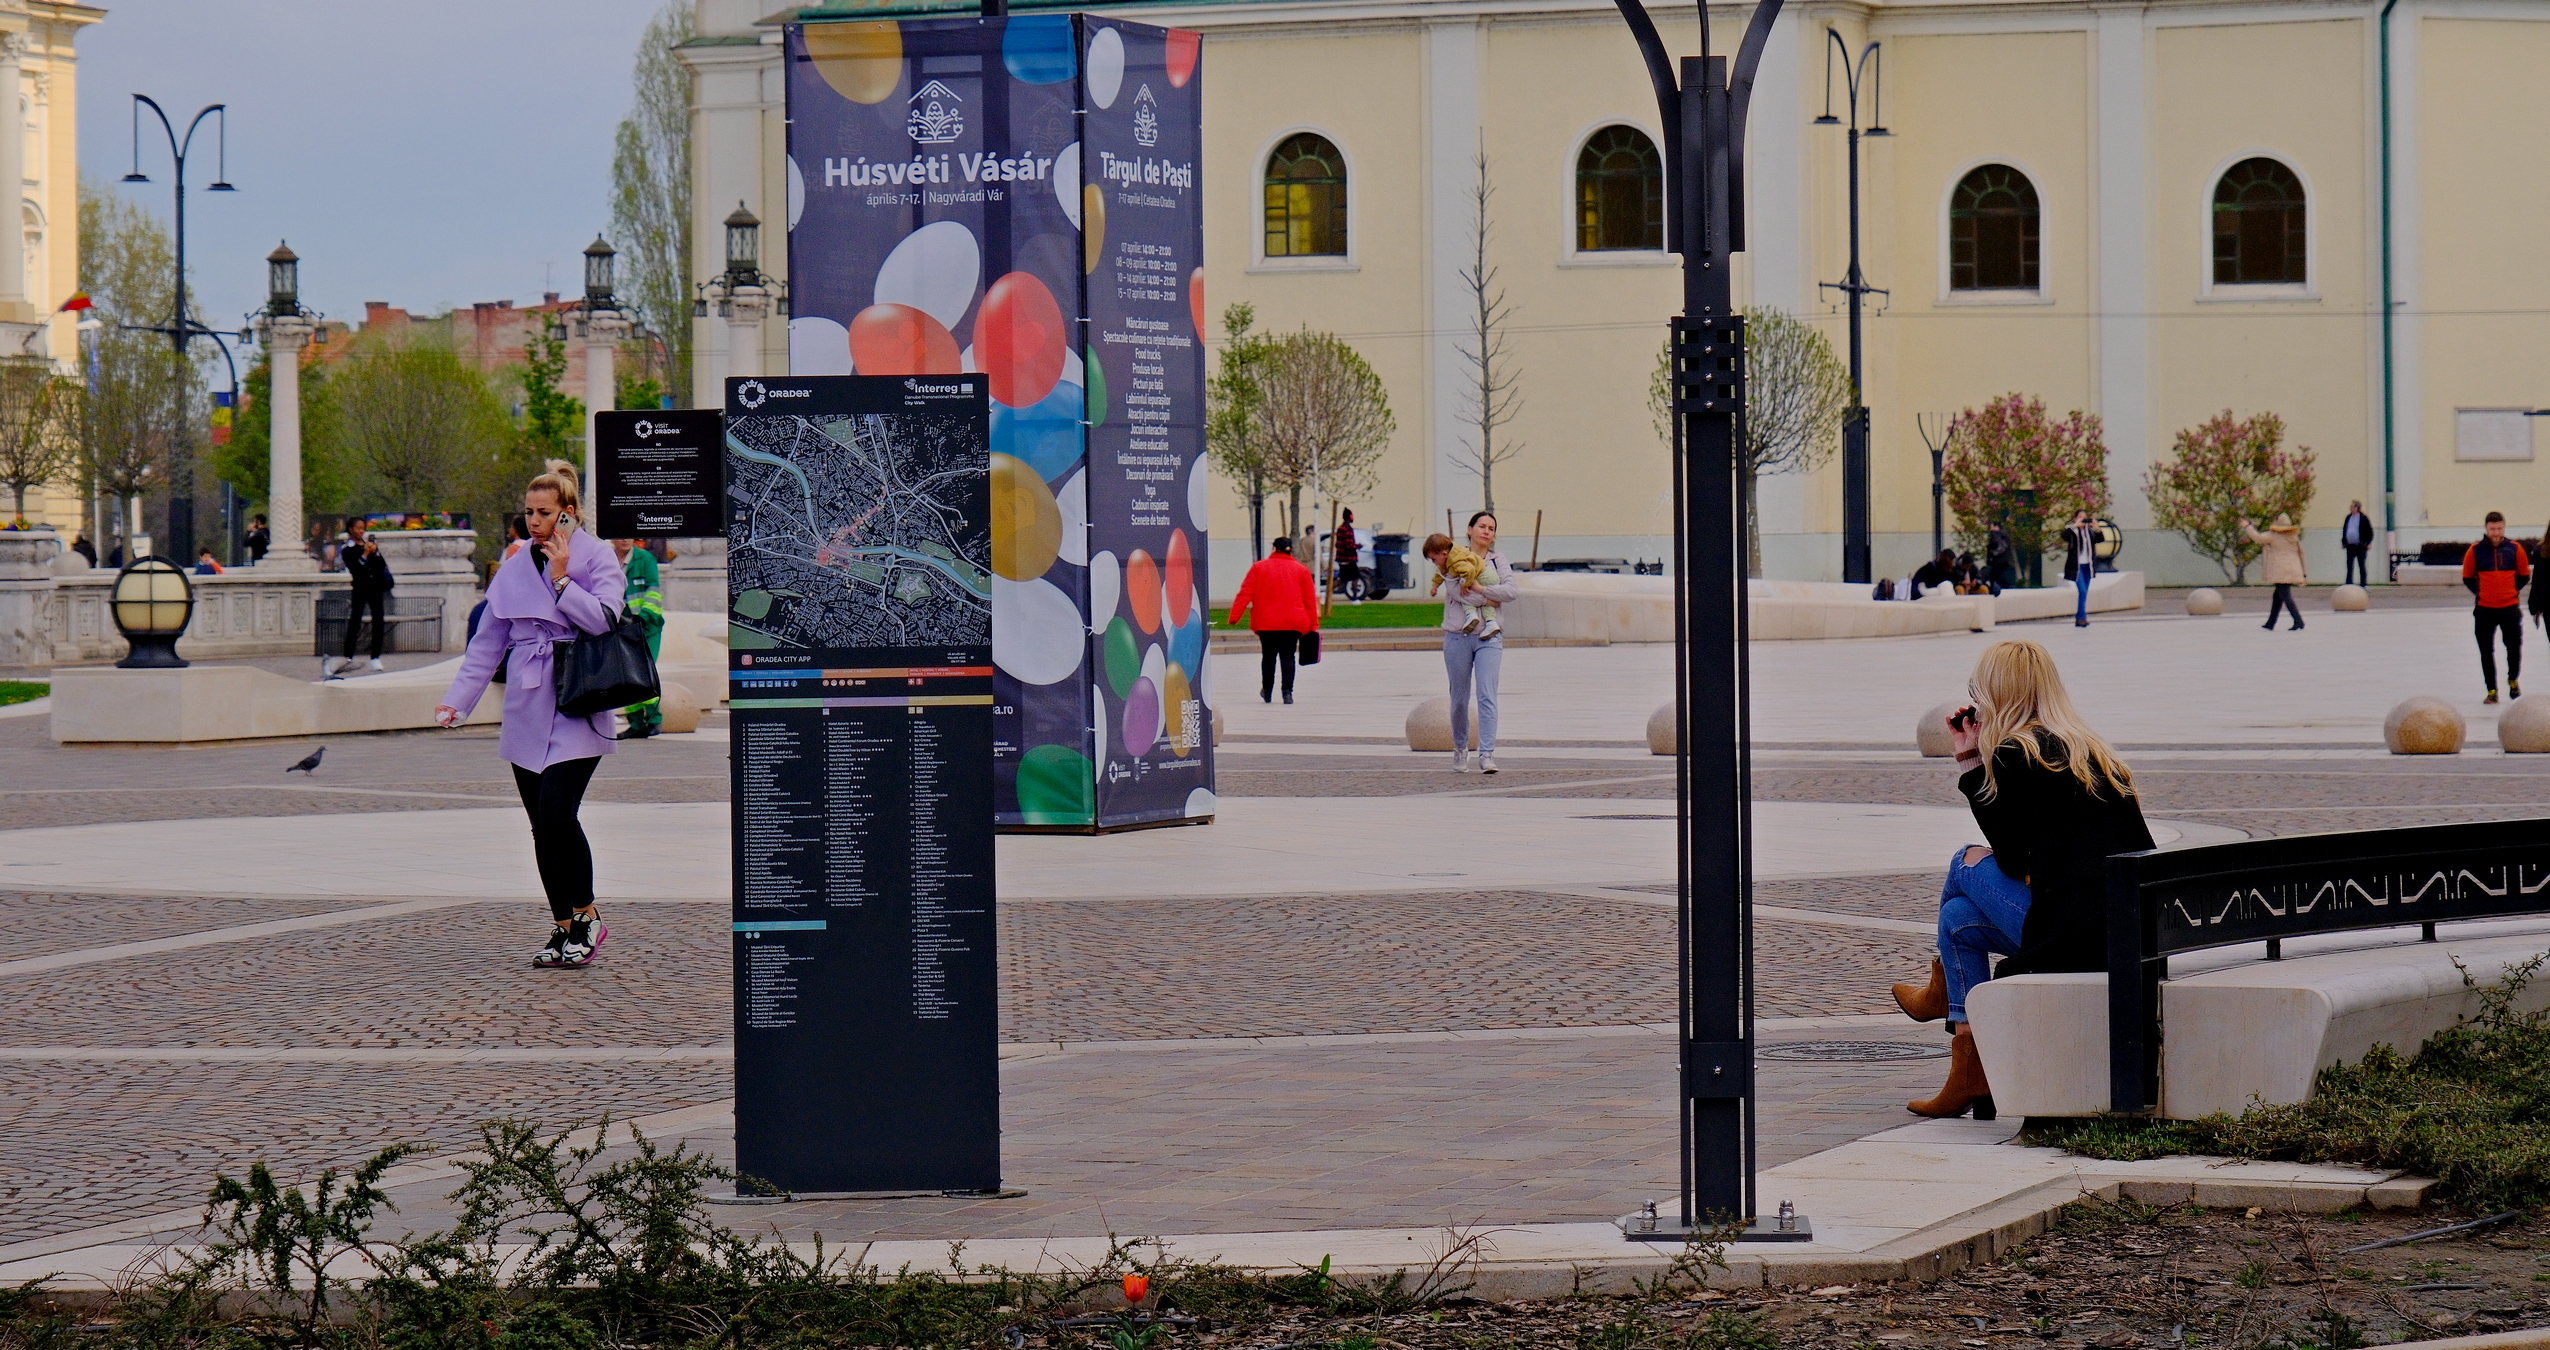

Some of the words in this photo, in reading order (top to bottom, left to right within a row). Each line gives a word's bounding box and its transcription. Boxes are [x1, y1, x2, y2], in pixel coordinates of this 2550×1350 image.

[825, 154, 948, 186] Húsvéti
[958, 151, 1051, 182] Vásár
[1101, 151, 1141, 188] Târgul
[1144, 158, 1159, 184] de
[1163, 159, 1191, 194] Paști
[866, 193, 897, 207] április
[899, 193, 920, 205] 7-17.
[929, 190, 984, 205] Nagyváradi
[987, 190, 1003, 201] Vár
[1127, 193, 1140, 206] aprilie
[1144, 194, 1160, 206] Cetatea
[1160, 196, 1175, 208] Oradea
[1126, 317, 1148, 329] Mâncăruri
[1149, 320, 1169, 332] gustoase
[1103, 330, 1128, 345] Spectacole
[1129, 332, 1146, 344] culinare
[1147, 336, 1152, 344] cu
[1153, 335, 1166, 349] rețete
[1167, 335, 1191, 350] tradiționale
[1135, 348, 1146, 359] Food
[1147, 349, 1161, 360] trucks
[1132, 363, 1150, 374] Produse
[1151, 363, 1164, 375] locale
[915, 384, 958, 394] Interreg
[1133, 378, 1148, 389] Picturi
[1149, 381, 1154, 392] pe
[1155, 379, 1164, 394] față
[1126, 393, 1147, 404] Labirintul
[1148, 393, 1171, 409] iepurașilor
[1128, 408, 1143, 423] Atracții
[1144, 410, 1158, 422] pentru
[1159, 409, 1170, 423] copii
[1131, 423, 1144, 435] Jocuri
[1145, 424, 1167, 435] interactive
[1130, 438, 1147, 450] Ateliere
[1148, 439, 1168, 450] educative
[1118, 450, 1136, 464] Întâlnire
[1137, 456, 1142, 464] cu
[1143, 453, 1163, 471] iepurașul
[1164, 454, 1169, 465] de
[1170, 454, 1181, 470] Paști
[1126, 468, 1145, 480] Decoruri
[1146, 468, 1151, 480] de
[1152, 469, 1174, 483] primăvară
[1145, 484, 1156, 498] Yoga
[1132, 499, 1149, 510] Cadouri
[1150, 499, 1169, 513] inspirate
[1132, 514, 1149, 525] Scenete
[1150, 514, 1156, 525] de
[1157, 515, 1170, 525] teatru
[993, 706, 1013, 714] a.ro
